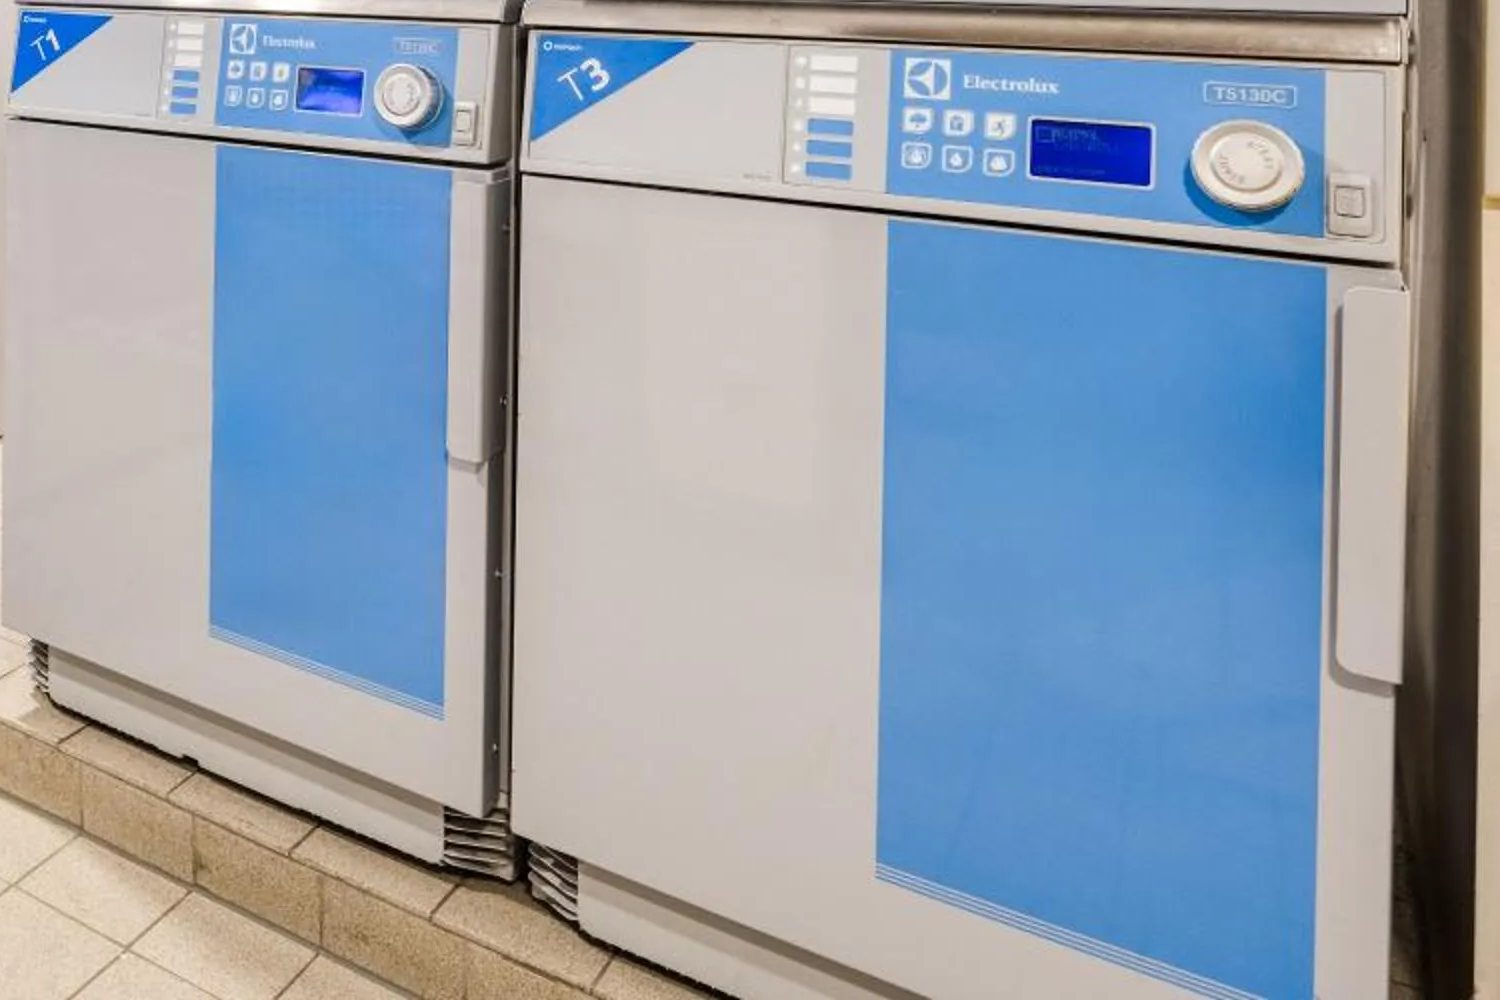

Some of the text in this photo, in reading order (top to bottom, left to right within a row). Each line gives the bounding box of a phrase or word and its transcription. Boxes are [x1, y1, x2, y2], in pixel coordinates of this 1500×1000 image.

[29, 28, 60, 61] T1
[557, 57, 610, 101] T3
[963, 73, 1060, 95] Electrolux
